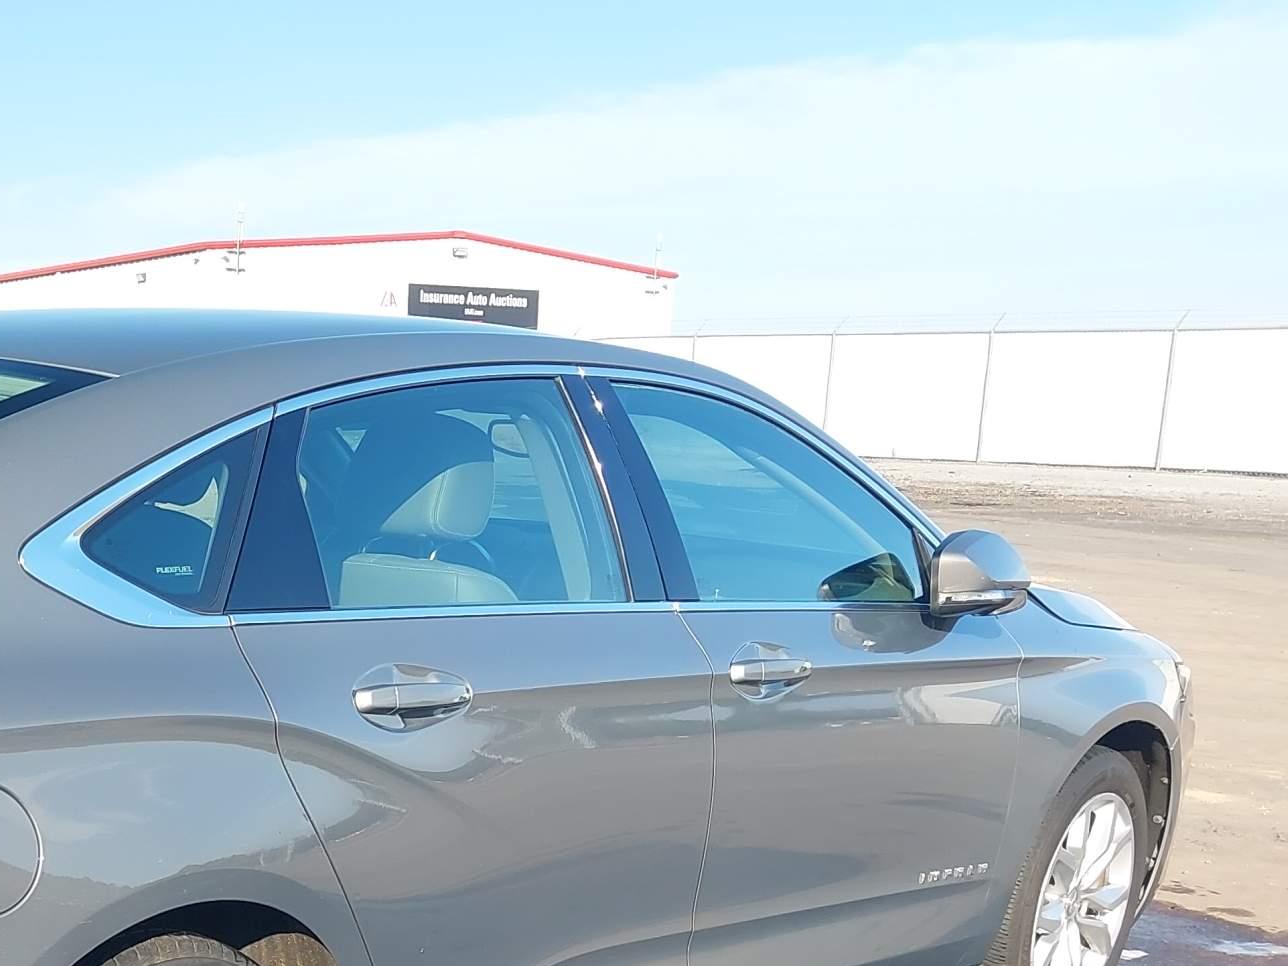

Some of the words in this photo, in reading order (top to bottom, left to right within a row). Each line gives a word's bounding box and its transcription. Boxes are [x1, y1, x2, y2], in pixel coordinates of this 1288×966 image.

[419, 288, 465, 306] Insurance
[466, 291, 488, 306] Auto
[488, 292, 528, 308] Auctions
